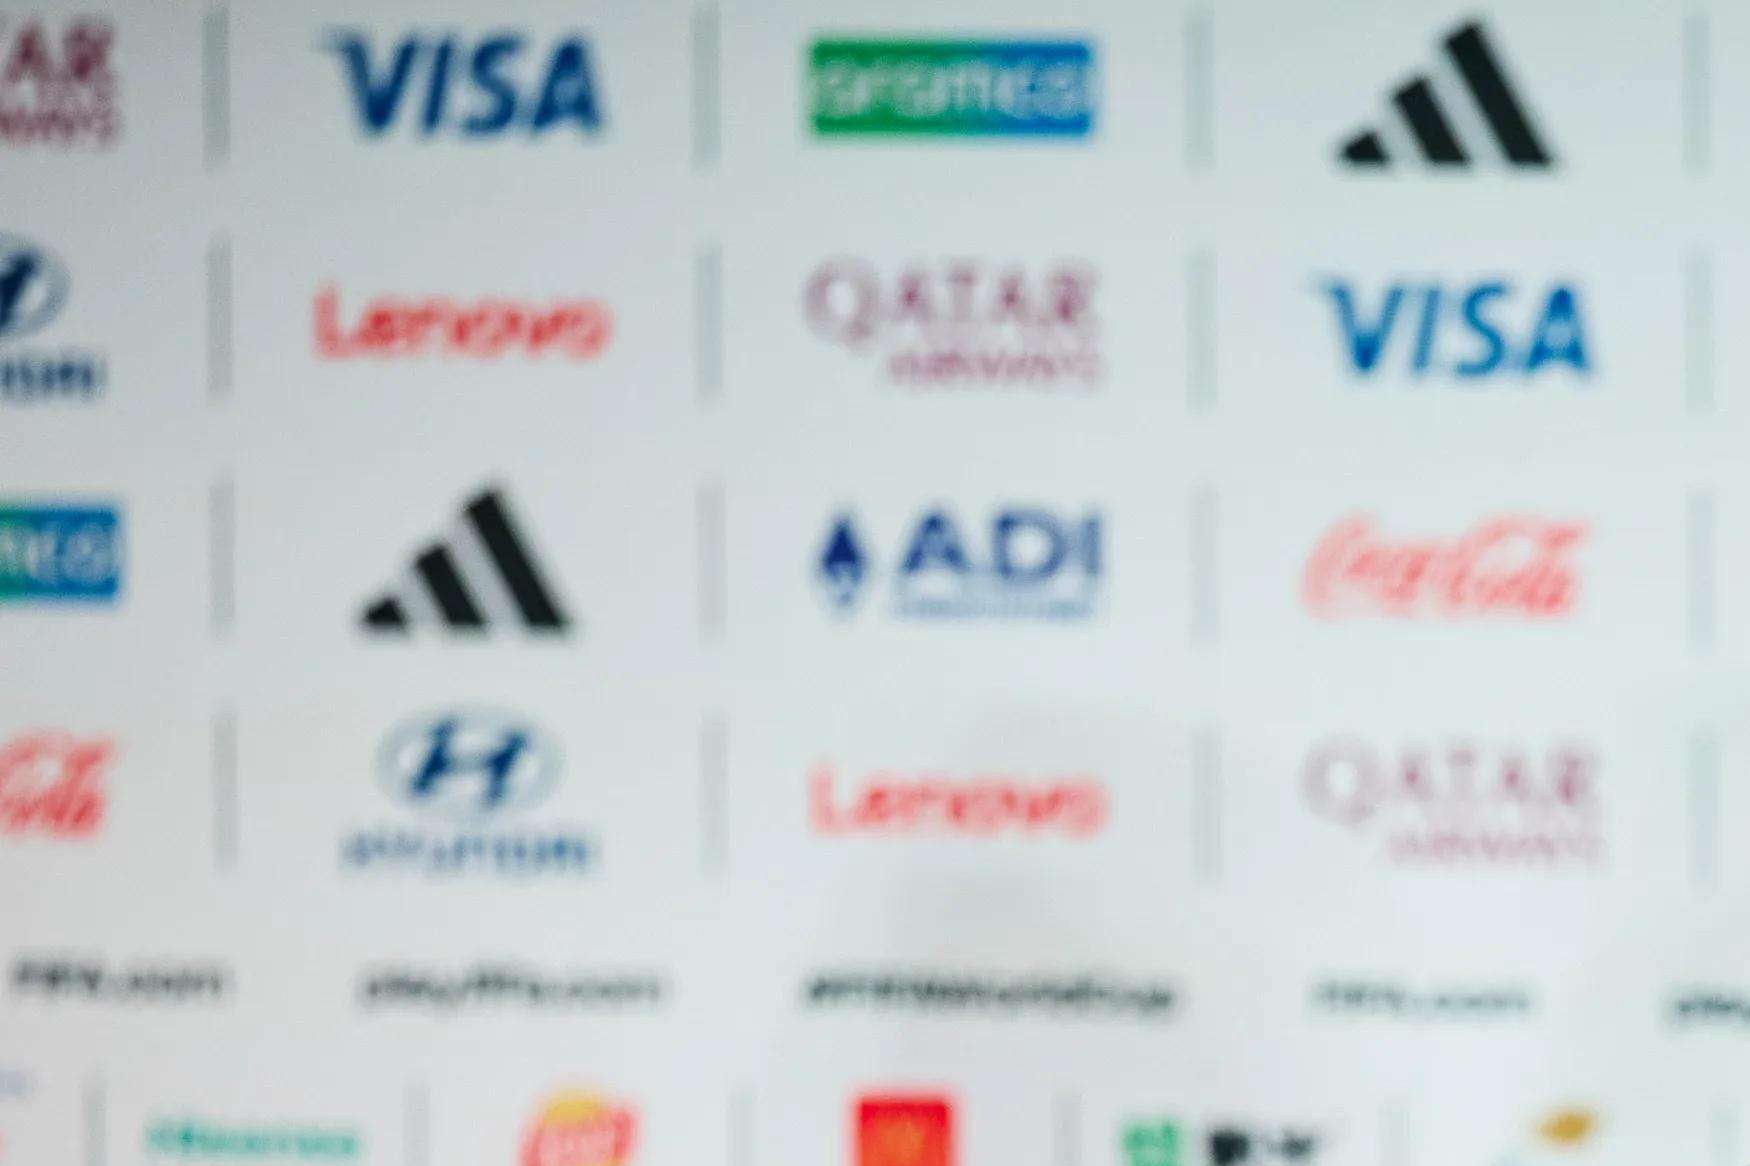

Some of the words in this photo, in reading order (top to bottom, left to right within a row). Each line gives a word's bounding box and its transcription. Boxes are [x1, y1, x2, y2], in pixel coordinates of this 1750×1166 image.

[322, 32, 604, 139] VISA
[312, 285, 610, 360] Lenovo
[802, 260, 1095, 350] QATAR
[1316, 279, 1593, 381] VISA
[900, 507, 1103, 581] ADI
